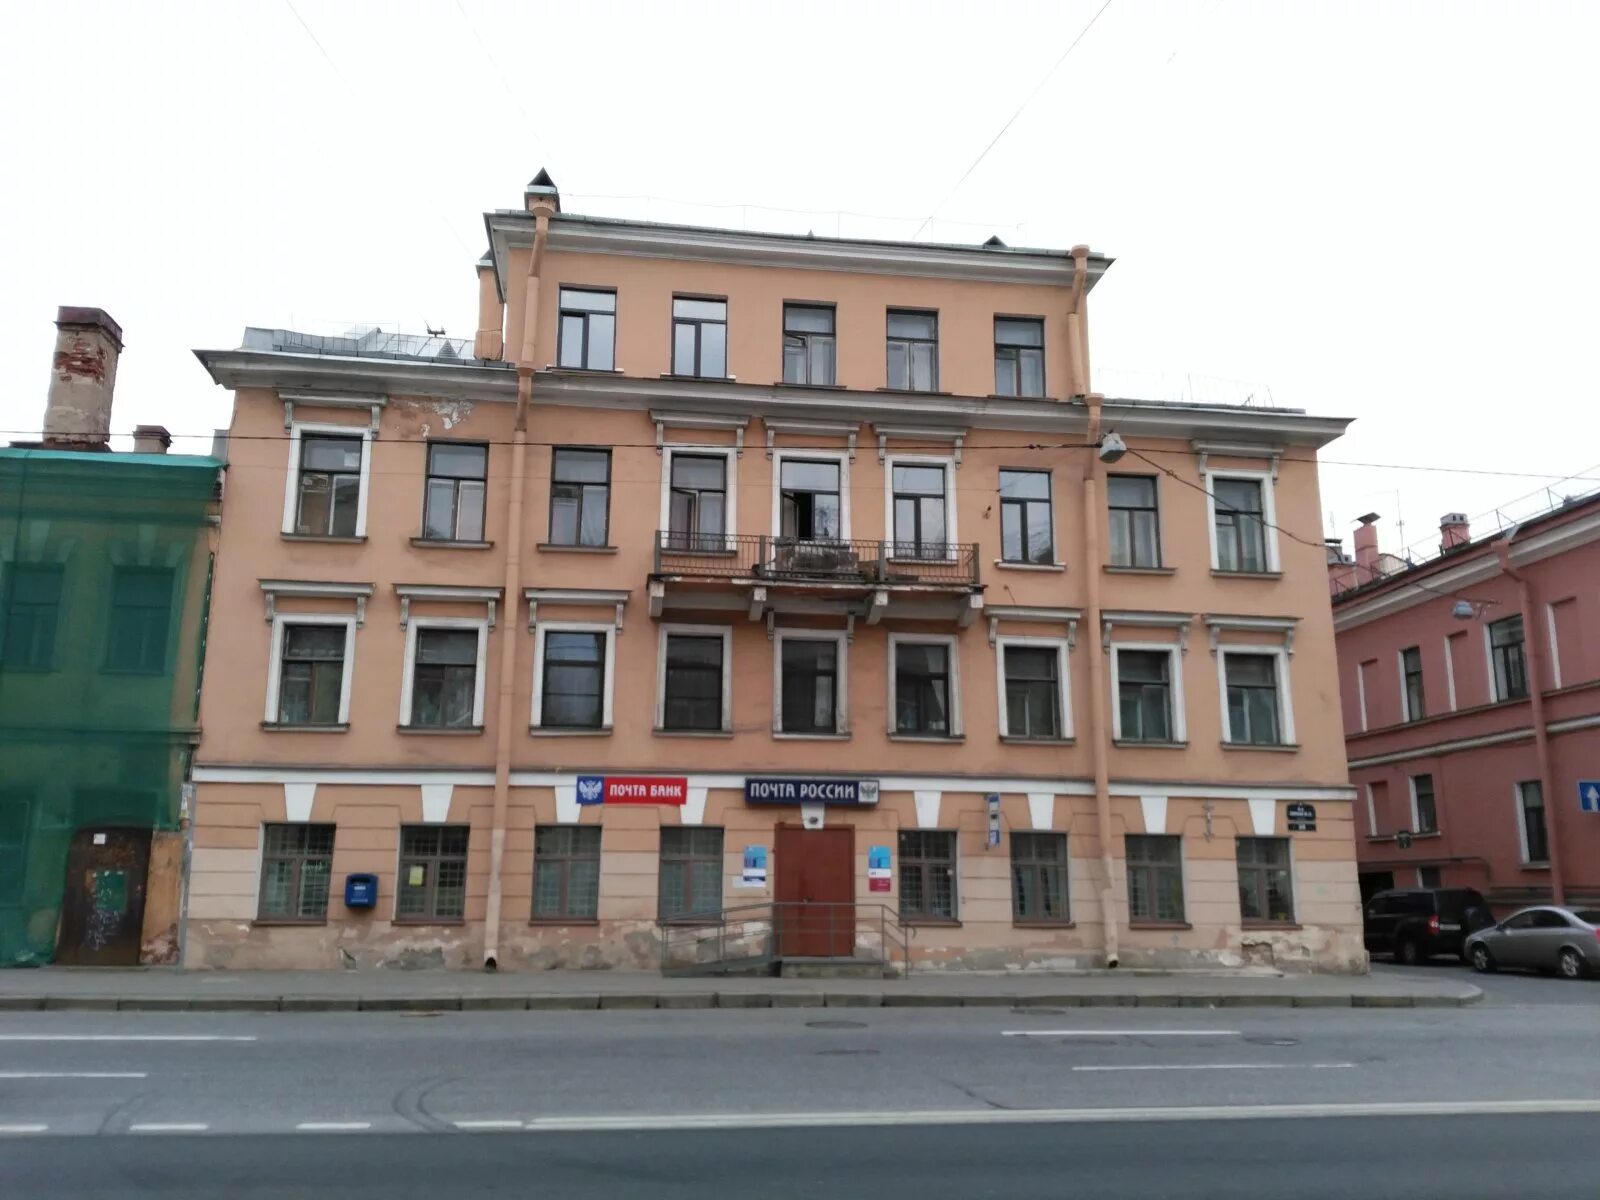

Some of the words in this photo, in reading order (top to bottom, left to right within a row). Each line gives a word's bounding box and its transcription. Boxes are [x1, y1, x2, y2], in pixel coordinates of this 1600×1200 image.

[610, 784, 646, 796] ПОЧТА
[650, 785, 682, 797] БАНК
[750, 783, 795, 798] ПОЧТА
[800, 783, 854, 799] РОССИИ
